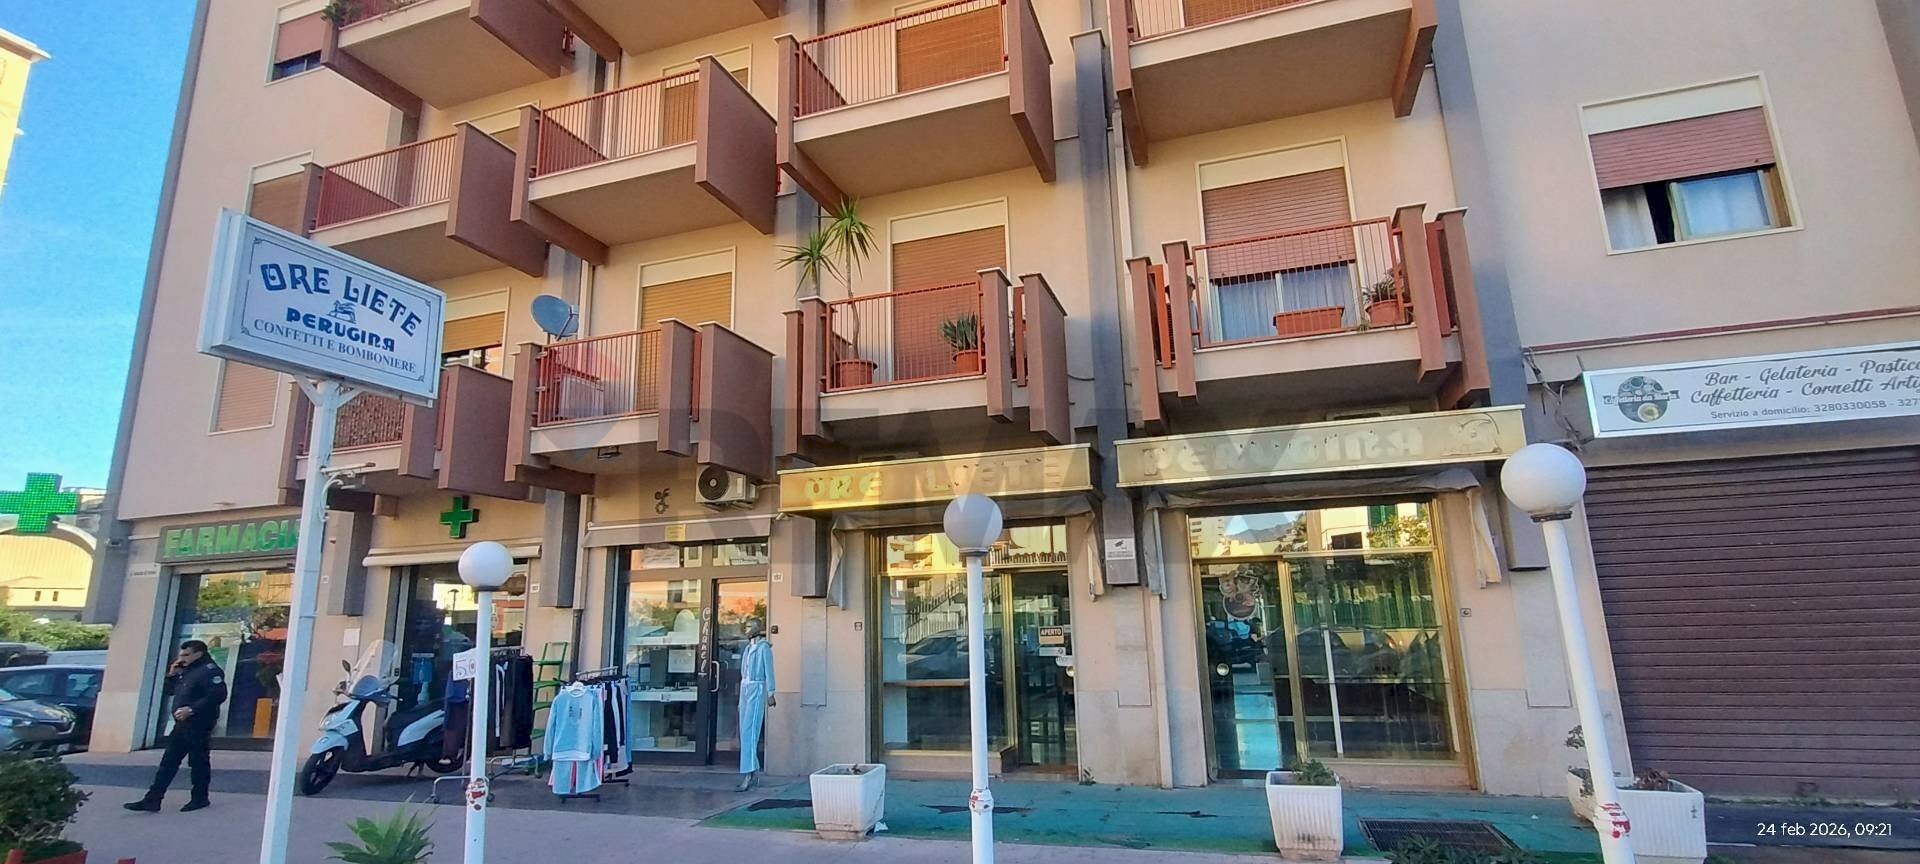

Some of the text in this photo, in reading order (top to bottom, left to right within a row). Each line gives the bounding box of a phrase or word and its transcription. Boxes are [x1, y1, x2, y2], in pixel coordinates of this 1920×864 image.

[260, 263, 422, 337] ORE LIETE
[286, 307, 395, 352] PERUGINA
[254, 318, 416, 374] CONFETTI E BOMBONIERE
[1704, 371, 1738, 386] Bar
[1760, 365, 1839, 385] Gelateria
[1690, 386, 1780, 407] Caffetteria
[1801, 378, 1873, 396] Cornetti
[1710, 408, 1750, 419] Servizio
[1761, 406, 1809, 416] domicilio:
[1040, 628, 1062, 636] APERTO
